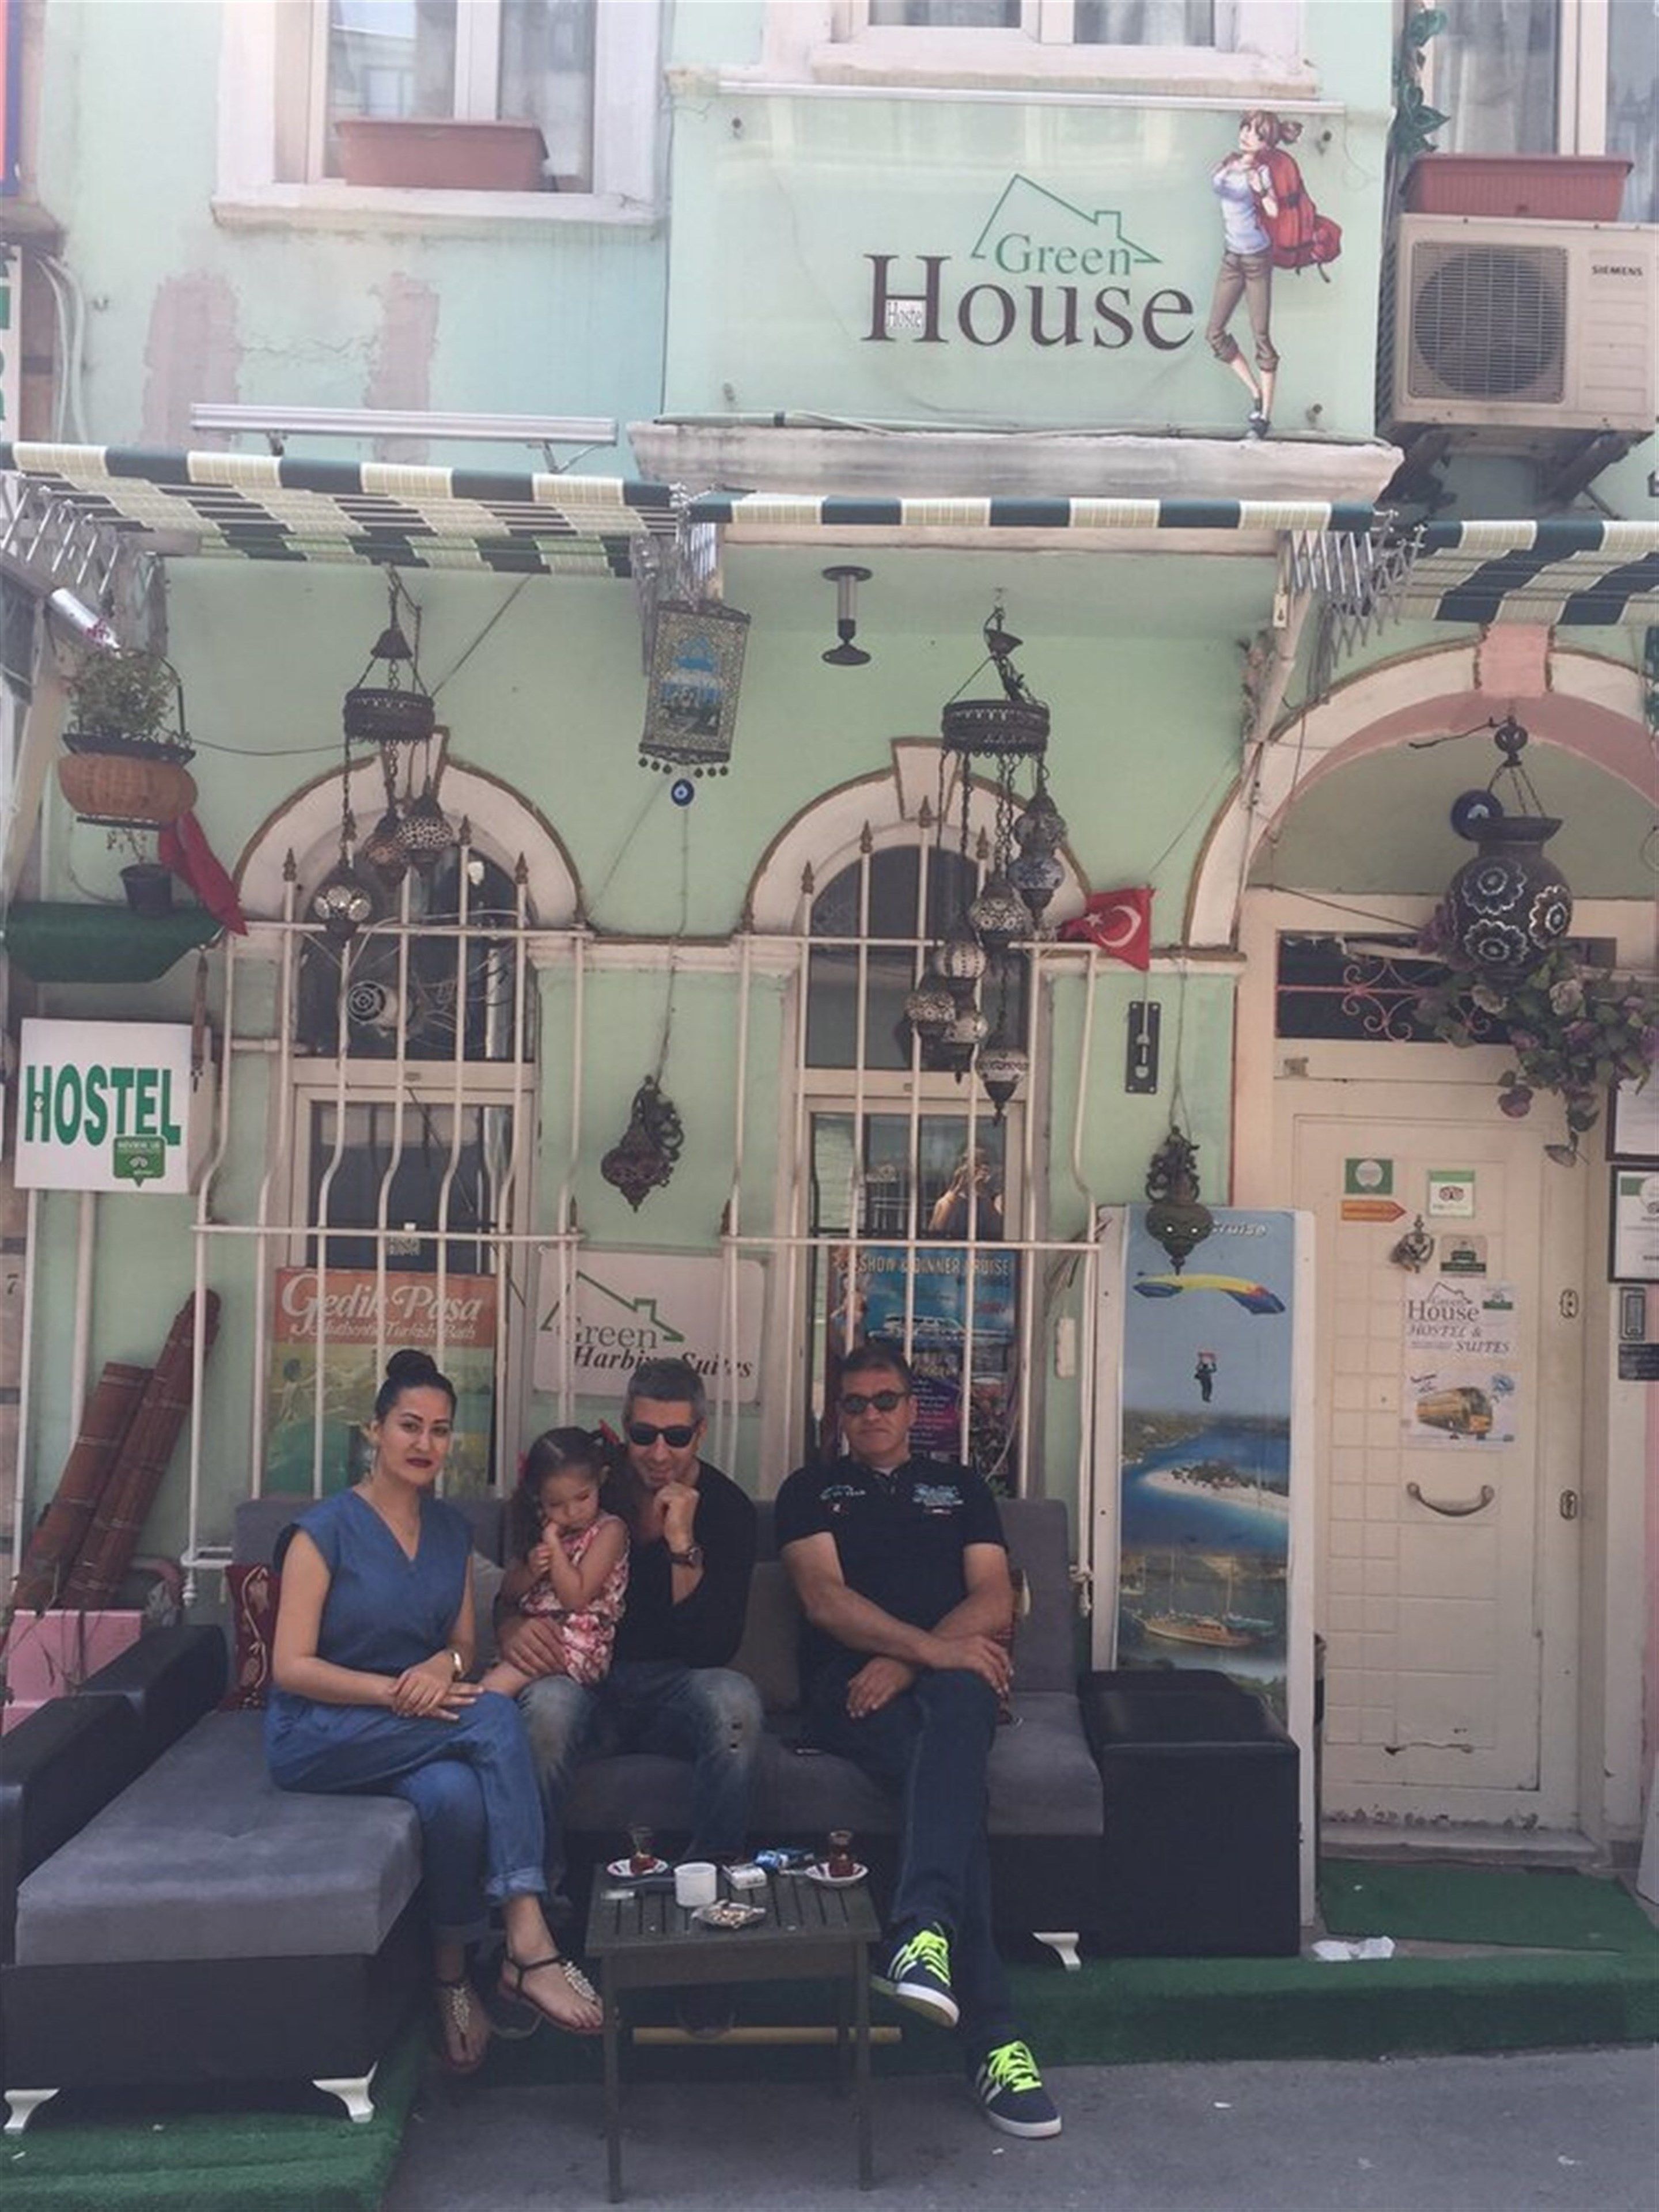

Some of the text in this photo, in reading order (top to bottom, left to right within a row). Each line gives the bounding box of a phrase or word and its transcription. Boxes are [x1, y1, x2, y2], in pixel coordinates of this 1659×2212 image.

[995, 233, 1131, 276] Green
[1592, 265, 1643, 276] SIEMENS
[861, 255, 1195, 351] House
[24, 1064, 181, 1146] HOSTEL
[1408, 1300, 1480, 1322] House
[574, 1345, 660, 1370] Harbi
